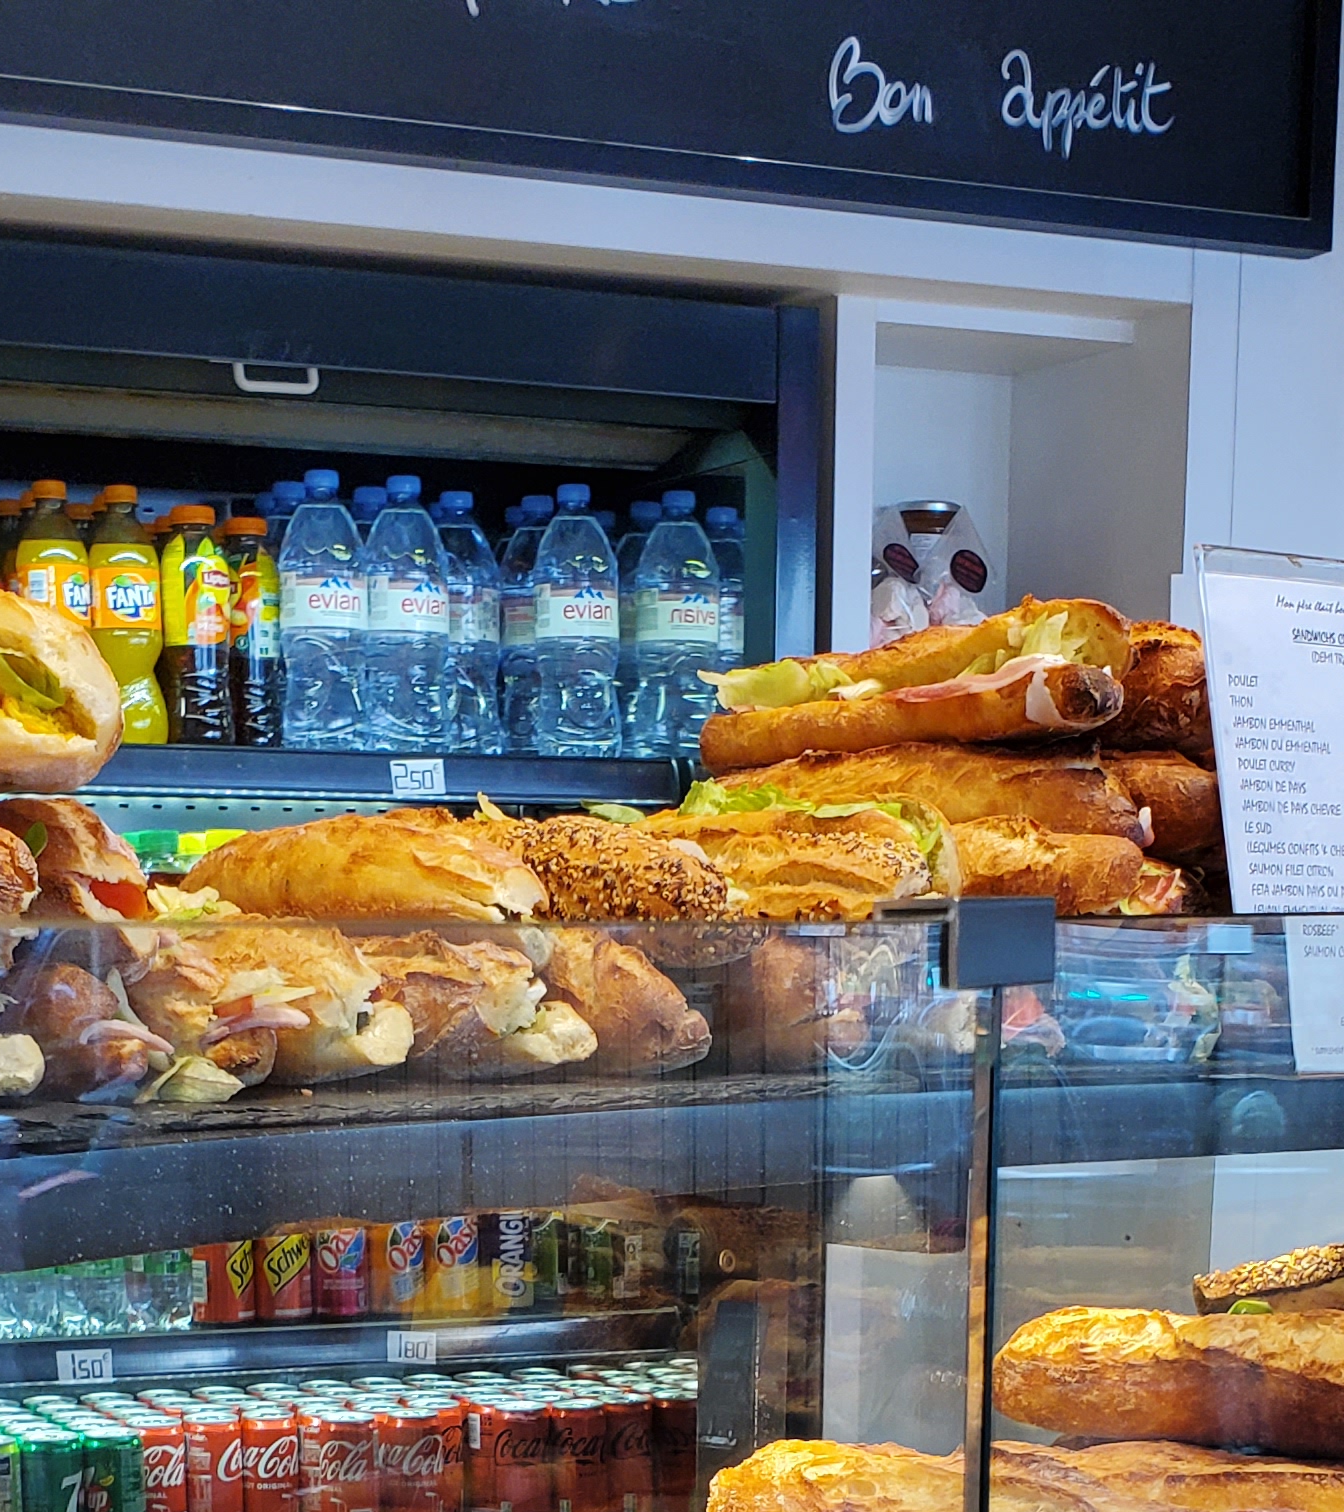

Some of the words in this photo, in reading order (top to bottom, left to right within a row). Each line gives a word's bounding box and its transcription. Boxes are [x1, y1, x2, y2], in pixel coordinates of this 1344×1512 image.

[828, 34, 934, 135] Bon
[308, 590, 362, 611] evian
[563, 601, 613, 621] evian
[1292, 628, 1335, 643] SANDWICHS
[1228, 674, 1258, 687] POULET
[1229, 695, 1253, 707] THON
[1233, 716, 1266, 729] JAMBON
[1269, 718, 1315, 733] EMMENTHAL
[1235, 737, 1268, 750] JAMBON
[1271, 740, 1283, 750] OU
[1286, 740, 1331, 754] EMMENTHAL
[1237, 758, 1267, 770] POULET
[1269, 760, 1295, 773] CURRY
[1240, 778, 1273, 791] JAMBON
[1276, 781, 1286, 792] DE
[1289, 782, 1306, 794] PAYS
[1242, 800, 1275, 813] JAMBON
[1278, 801, 1289, 813] DE
[1291, 802, 1308, 815] PAYS
[1311, 804, 1341, 816] CHEVRE
[1245, 821, 1254, 833] LE
[1256, 822, 1272, 834] SUD
[1247, 841, 1285, 856] (LEGUMES
[1288, 842, 1319, 856] CONFITS
[1249, 863, 1282, 875] SAUMON
[1286, 864, 1304, 876] FILET
[1307, 865, 1334, 877] CITRON
[1252, 884, 1269, 896] FETA
[1272, 884, 1304, 897] JAMBON
[1307, 885, 1325, 897] PAYS
[1327, 887, 1338, 898] OU
[1304, 945, 1336, 957] SAUMON
